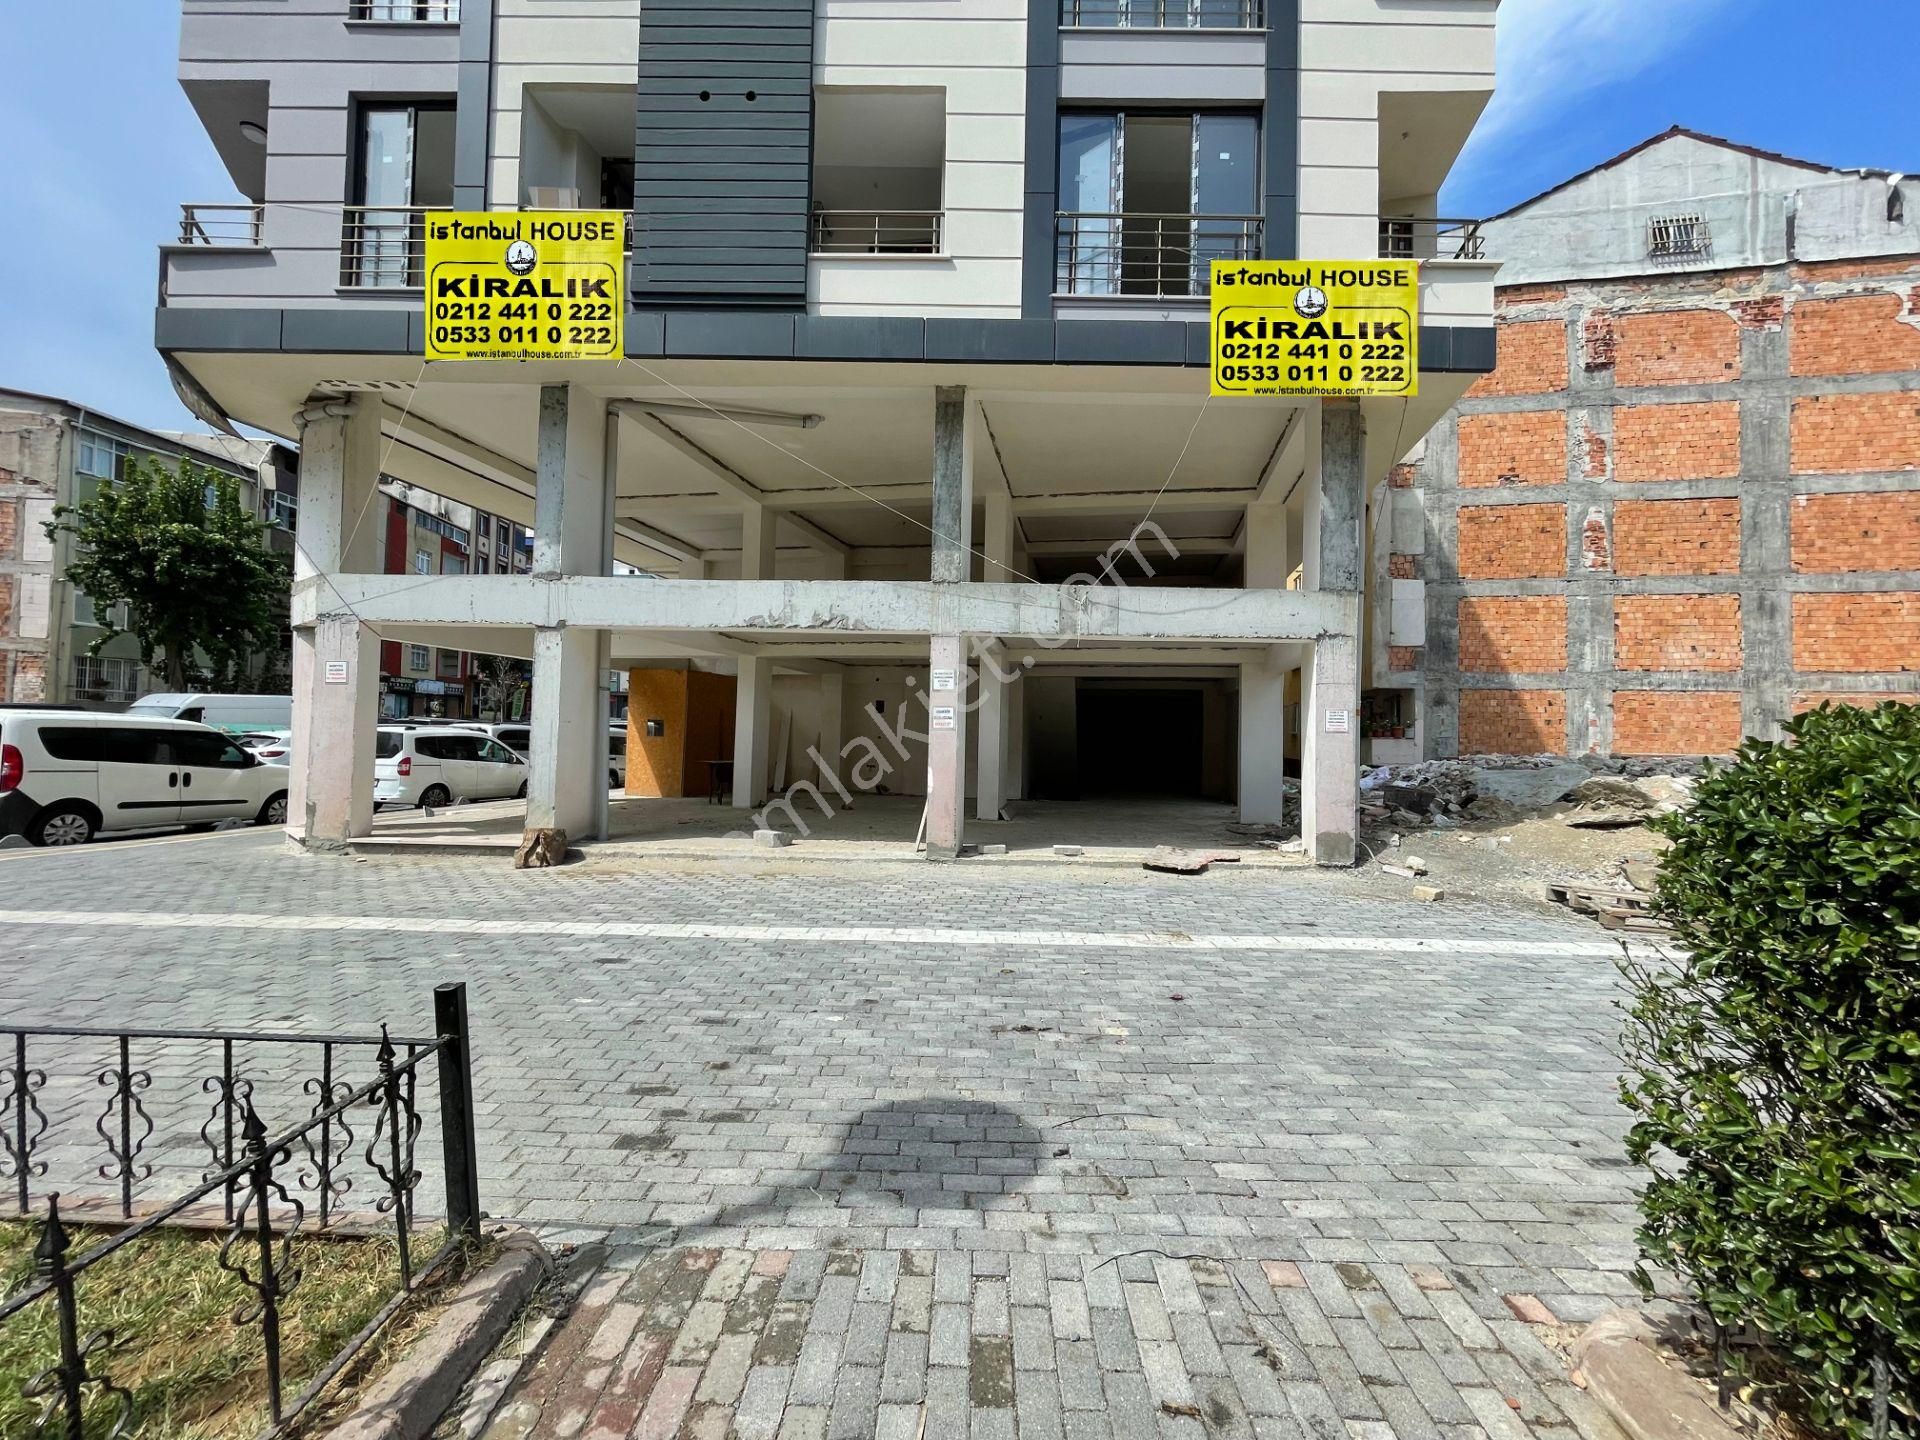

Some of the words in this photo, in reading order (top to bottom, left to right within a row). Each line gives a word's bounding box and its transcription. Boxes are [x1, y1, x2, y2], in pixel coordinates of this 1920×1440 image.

[431, 220, 521, 241] istanbul
[531, 222, 614, 241] HOUSE
[438, 273, 610, 298] KİRALIK
[1217, 268, 1311, 286] istanbul
[1321, 270, 1409, 287] HOUSE
[436, 303, 490, 320] 0212
[499, 303, 537, 320] 441
[548, 304, 561, 320] 0
[569, 304, 611, 320] 222
[436, 327, 490, 343] 0533
[499, 327, 537, 343] 011
[548, 327, 561, 343] 0
[569, 327, 611, 344] 222
[1225, 316, 1403, 340] KİRALIK
[1222, 344, 1279, 359] 0212
[1288, 344, 1328, 359] 441
[1339, 344, 1352, 359] 0
[1361, 344, 1404, 360] 222
[1222, 366, 1279, 381] 0533
[1288, 366, 1327, 381] 011
[1339, 366, 1352, 381] 0
[1361, 366, 1404, 381] 222
